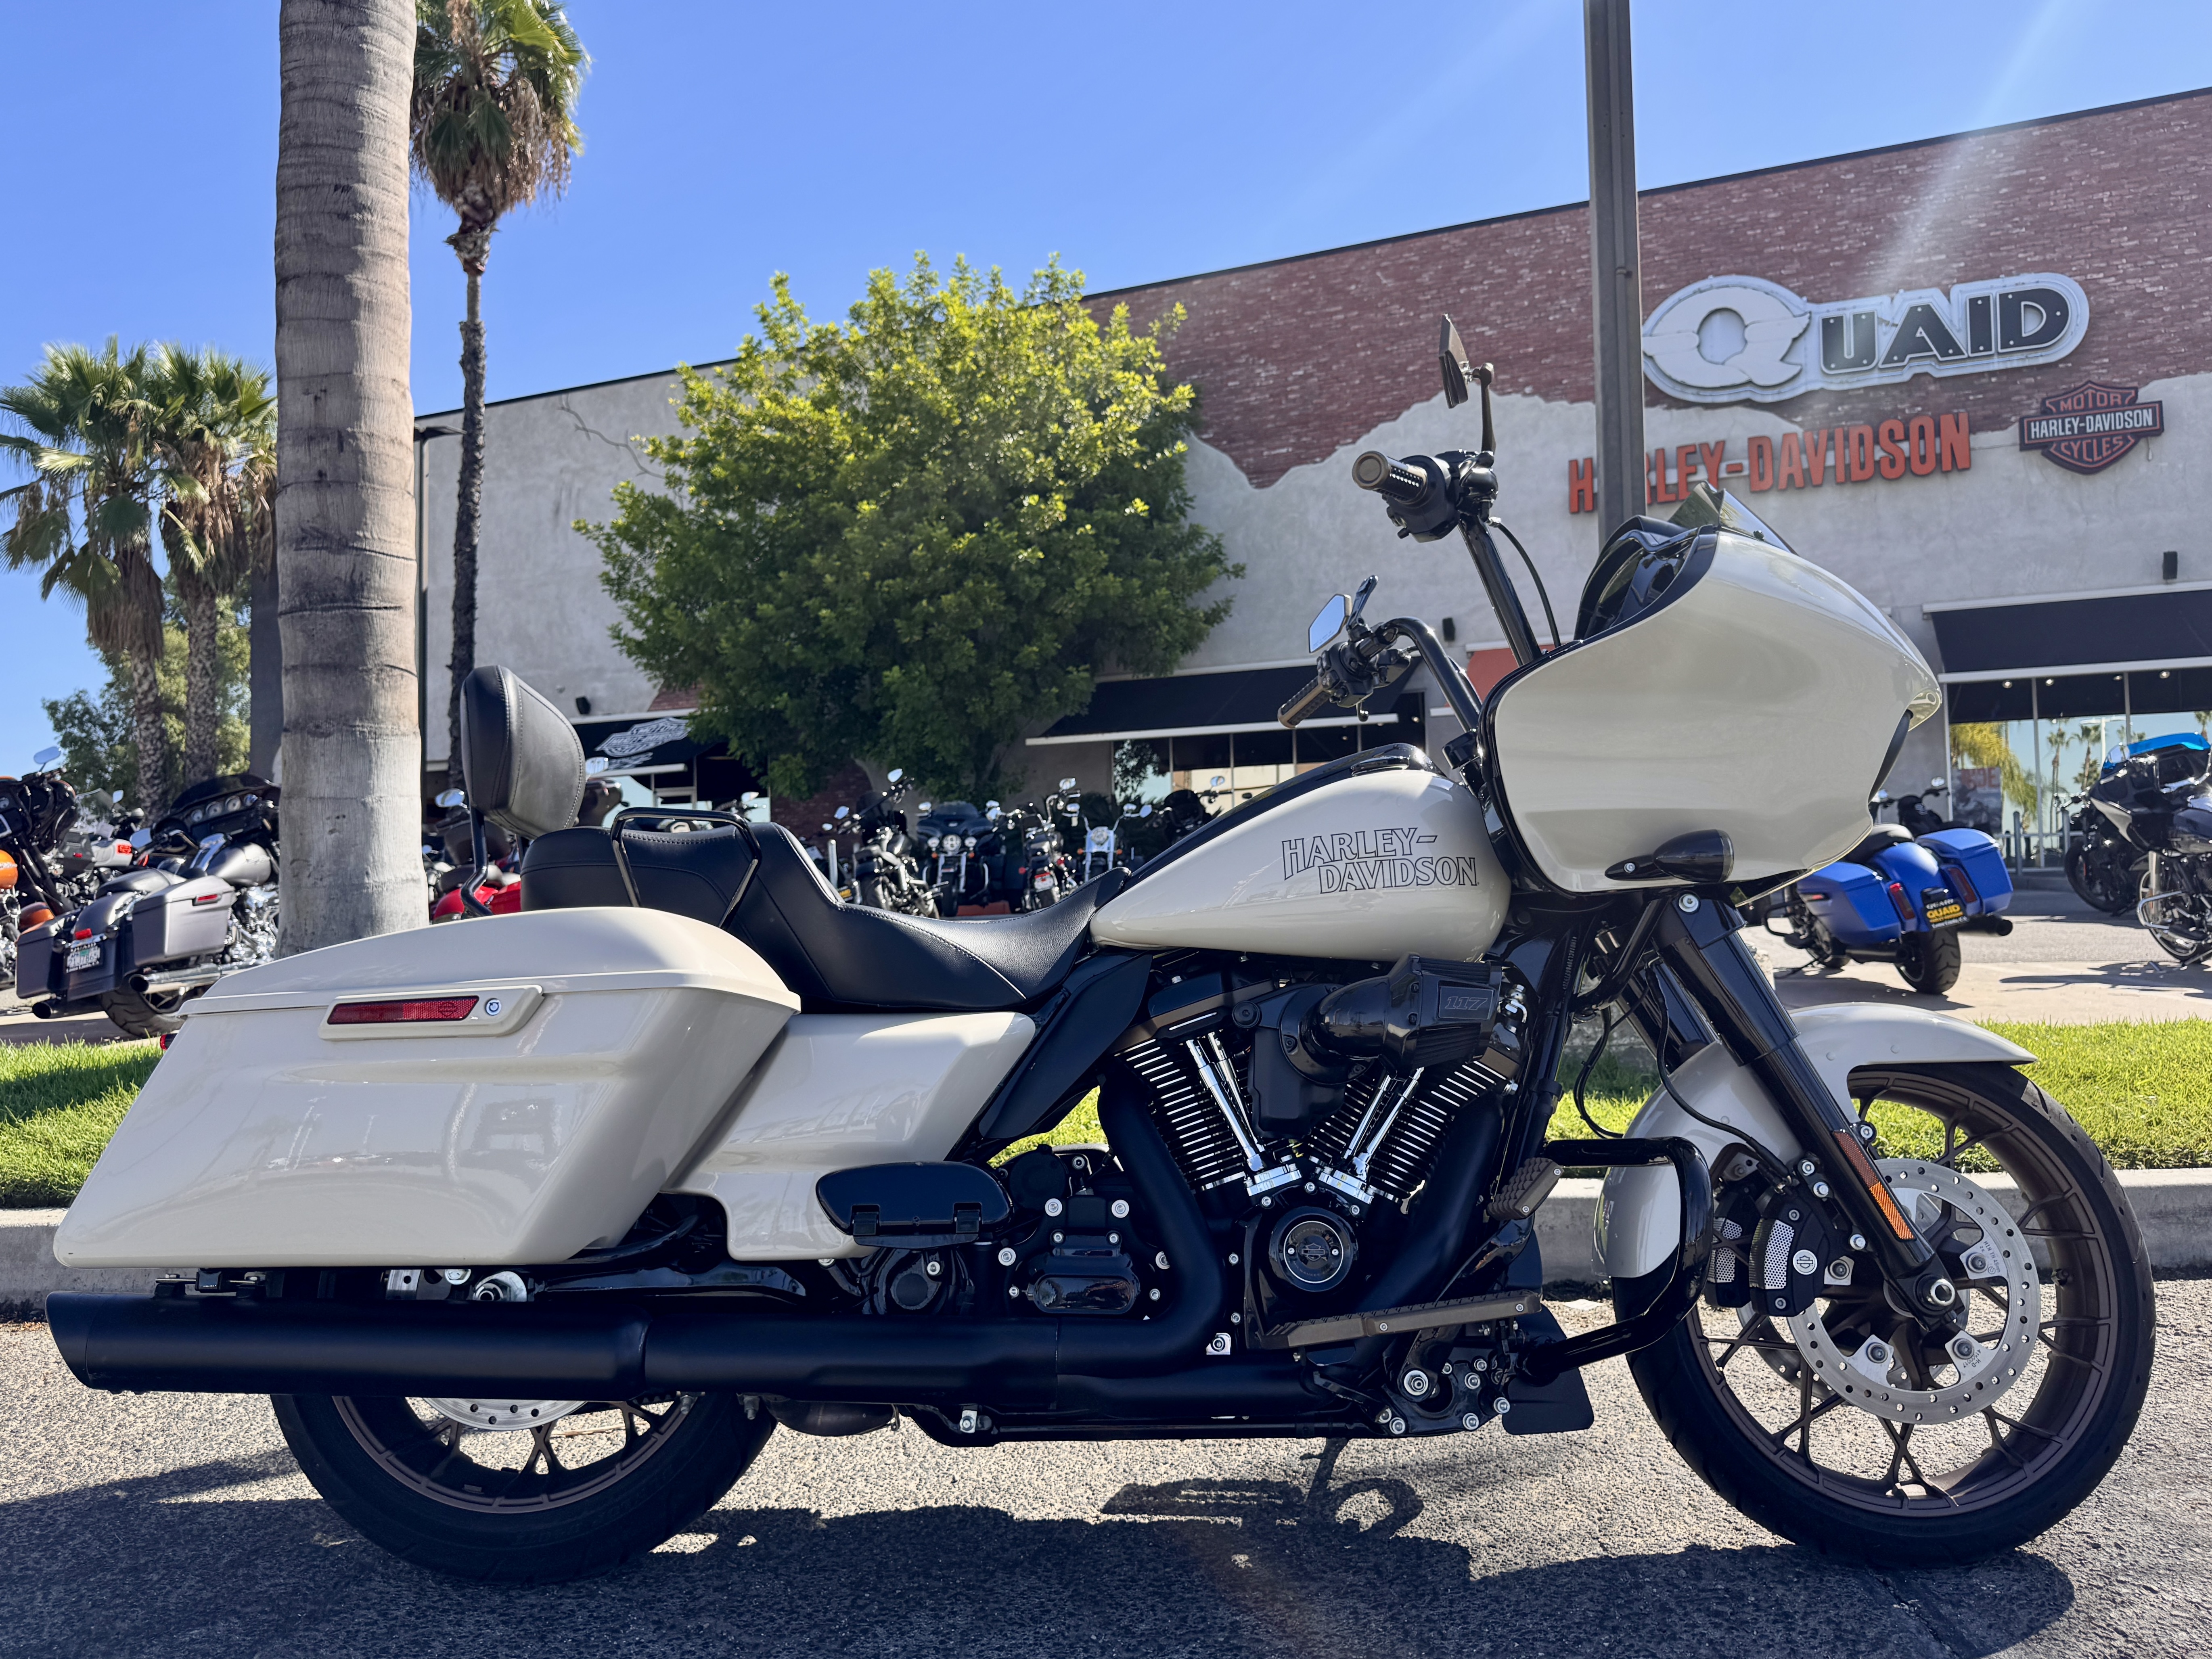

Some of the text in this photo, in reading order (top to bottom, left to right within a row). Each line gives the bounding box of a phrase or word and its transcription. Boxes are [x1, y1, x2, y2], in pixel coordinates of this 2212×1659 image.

[1642, 286, 2072, 388] QUAID
[2060, 389, 2122, 412] MOTOR
[2030, 408, 2153, 439] HARLEY-DAVIDSON
[1568, 412, 1971, 514] HLEY-DAVIDSON
[2060, 435, 2123, 462] CYCLES
[1281, 827, 1438, 881] HARLEY-
[1318, 856, 1477, 894] DAVIDSON
[1926, 904, 1961, 919] QUAID
[1444, 996, 1488, 1011] 117
